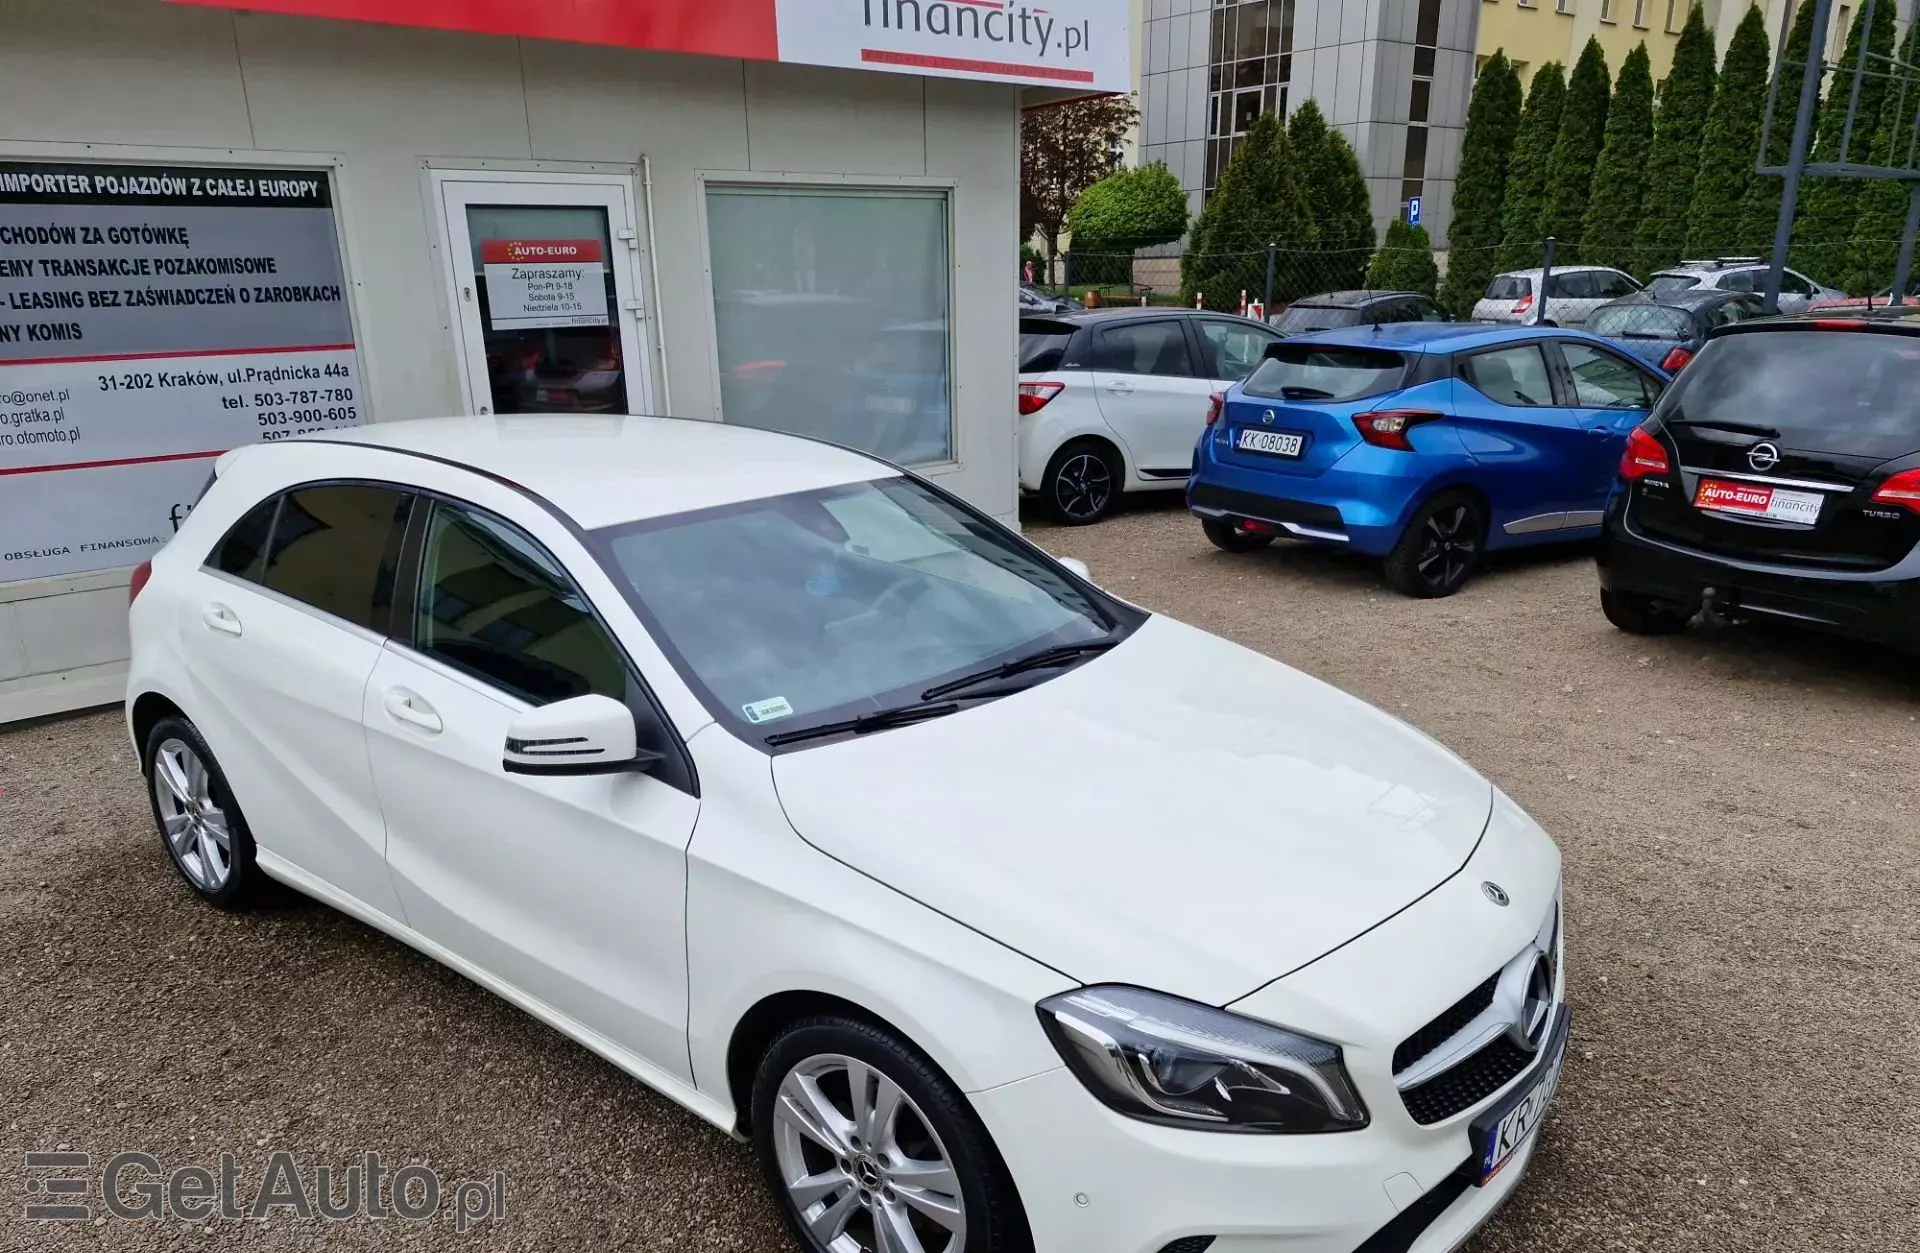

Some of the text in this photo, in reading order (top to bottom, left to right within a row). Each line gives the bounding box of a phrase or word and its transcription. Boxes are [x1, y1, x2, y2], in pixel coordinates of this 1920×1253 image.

[0, 173, 319, 198] IMPORTER POJAZDÓW Z CAŁEJ EUROPY
[1410, 200, 1419, 221] P
[0, 222, 190, 249] CHODÓW ZA GOTÓWKĘ
[514, 246, 577, 256] AUTO-EURO
[0, 256, 277, 277] EMY TRANSAKCJE POZAKOMISOWE
[511, 267, 585, 281] Zapraszamy:
[8, 291, 84, 309] LEASING
[88, 290, 122, 308] BEZ
[125, 284, 237, 307] ZAŚWIADCZEŃ
[239, 287, 250, 304] O
[254, 285, 341, 304] ZAROBKACH
[527, 282, 573, 291] Pon-Pt 9-18
[528, 292, 575, 302] Sobota 9-15
[523, 303, 582, 312] Niedziela 10-15
[0, 323, 82, 342] NY KOMIS
[98, 363, 349, 392] 31-202 Kraków, ul.Prądnicka 44a
[222, 388, 353, 410] tel. 503-787-780
[0, 406, 65, 427] o.gratka.pl
[258, 406, 357, 426] 503-900-605
[0, 426, 81, 446] ro.otomoto.pl
[1242, 431, 1258, 448] KK
[1260, 434, 1298, 453] 08038
[1704, 488, 1767, 505] AUTO-EURO
[4, 535, 167, 562] OBSŁUGA FINANSOWA:
